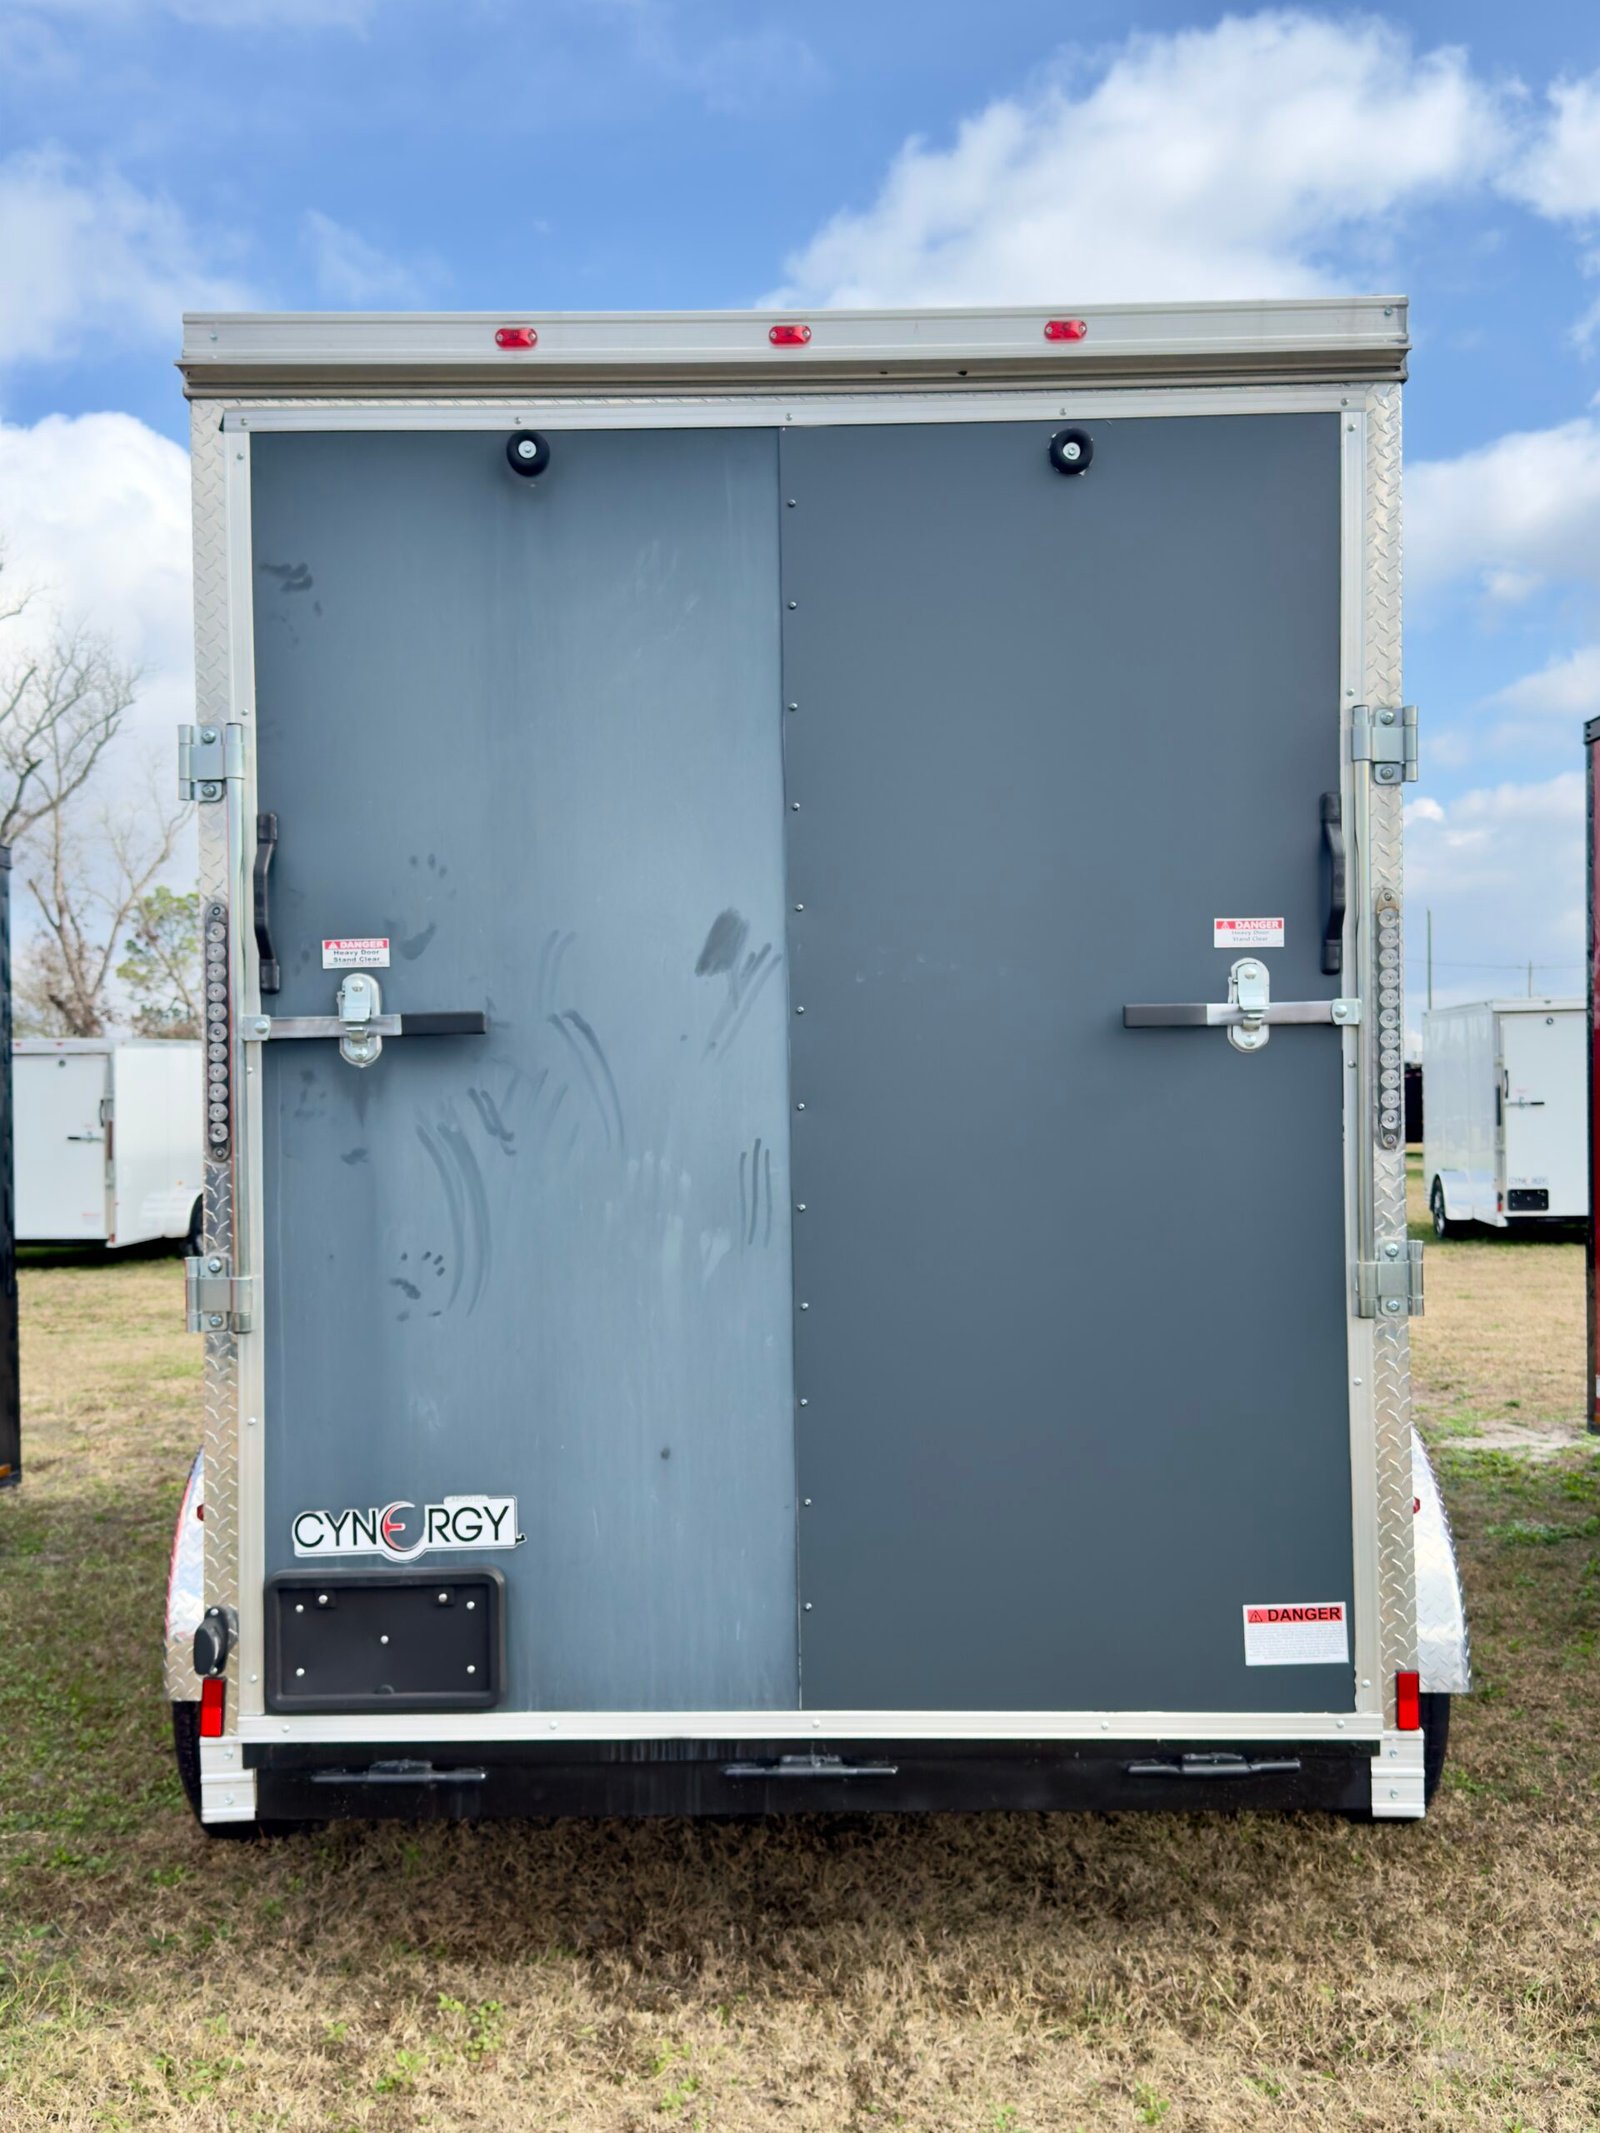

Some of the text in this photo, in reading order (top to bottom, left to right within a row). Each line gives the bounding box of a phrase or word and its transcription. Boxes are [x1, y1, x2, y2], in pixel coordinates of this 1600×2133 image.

[1235, 920, 1279, 929] DANGER
[340, 940, 384, 949] DANGER
[294, 1502, 510, 1551] CYNERGY
[1267, 1607, 1341, 1622] DANGER
